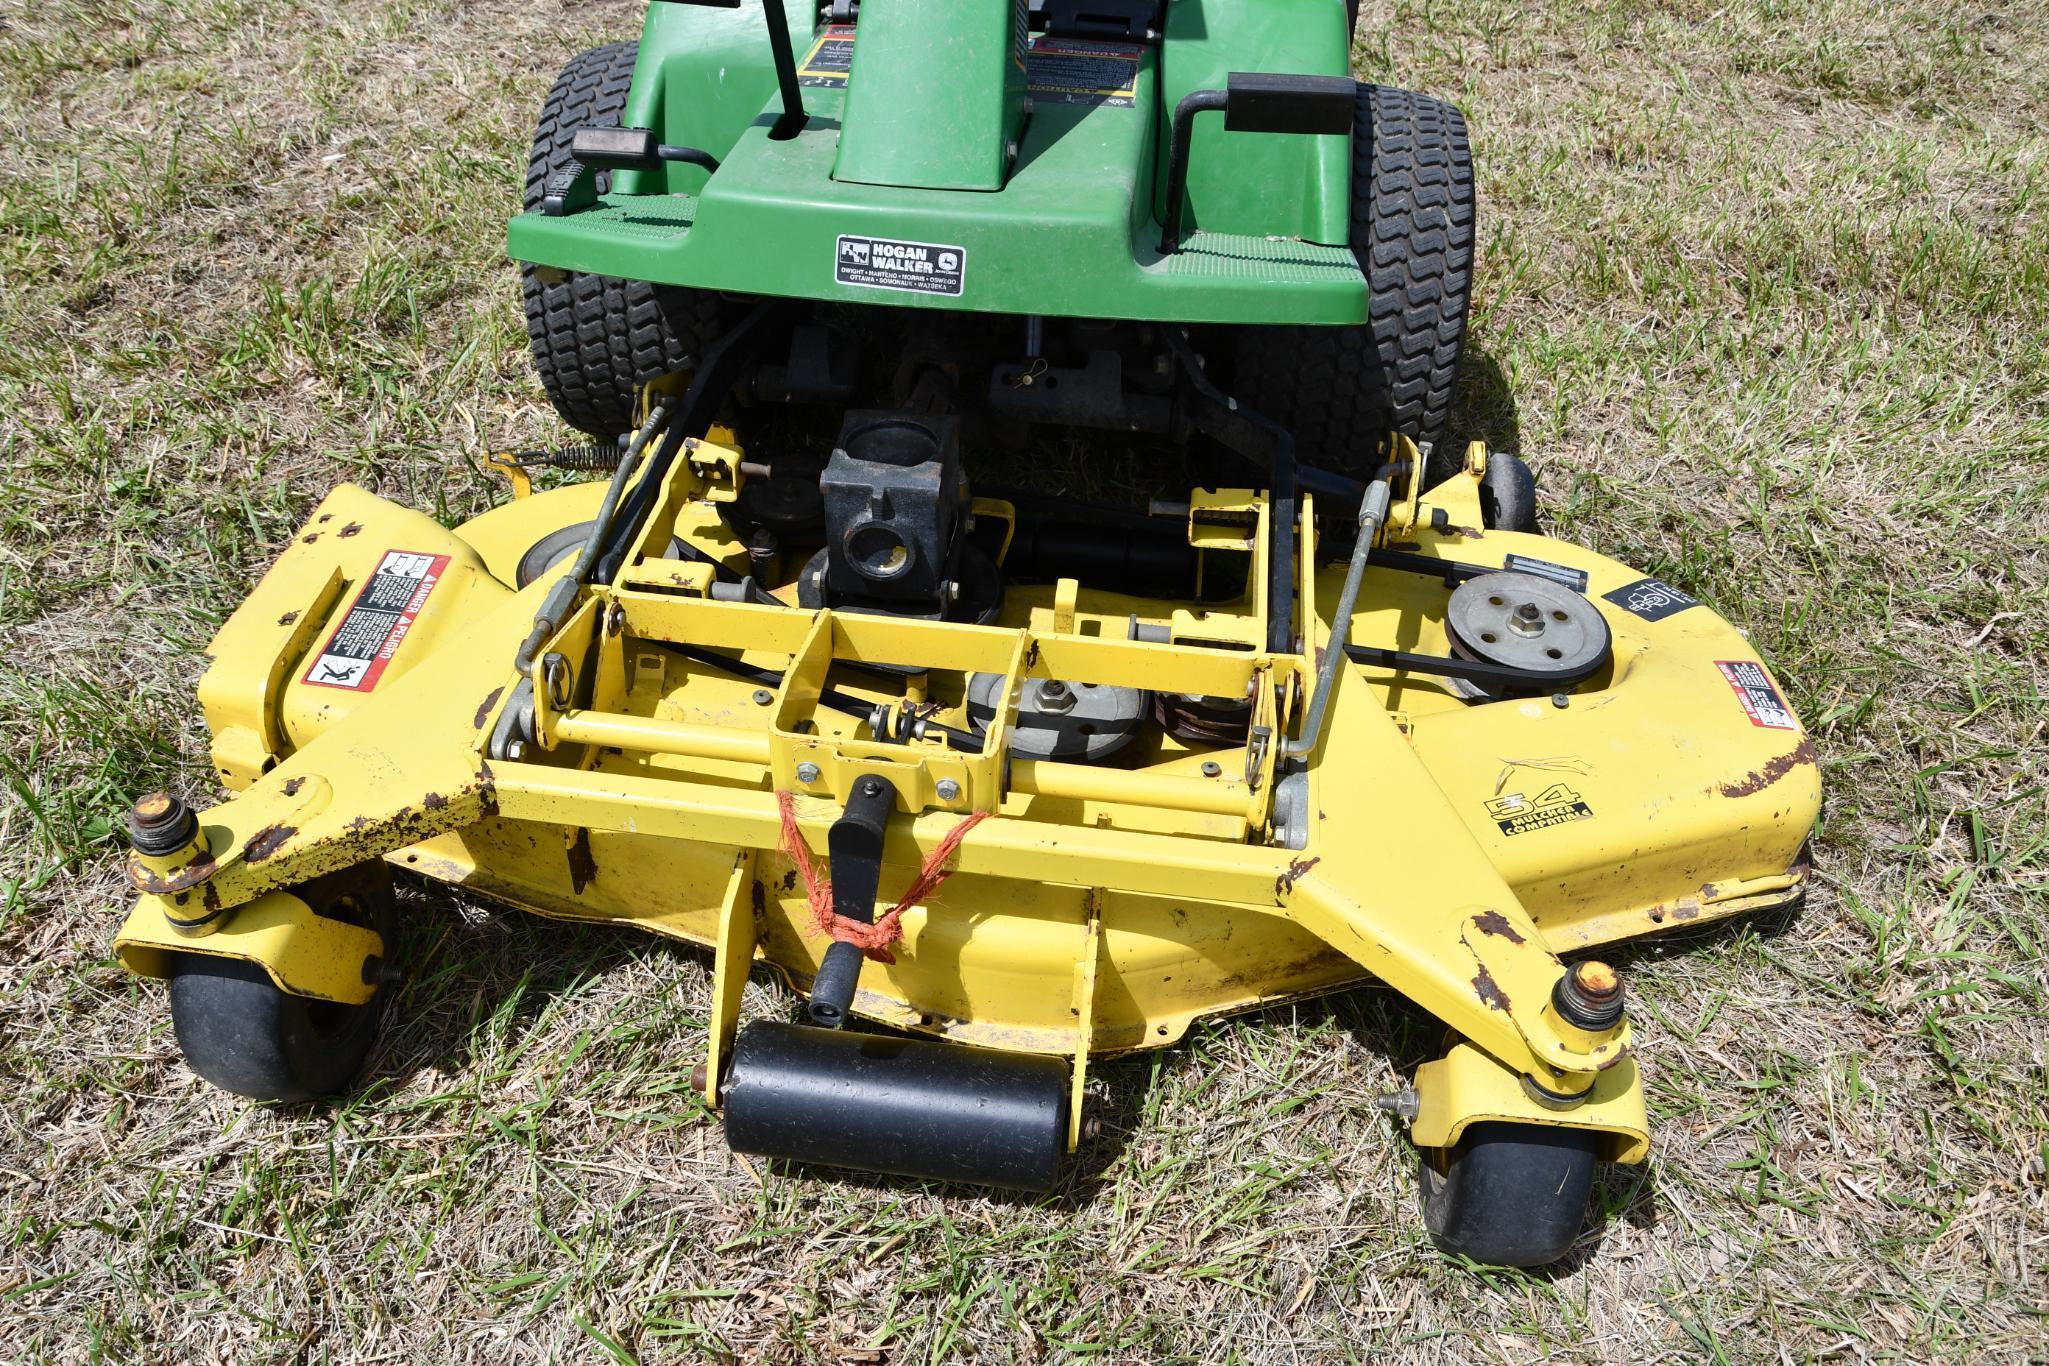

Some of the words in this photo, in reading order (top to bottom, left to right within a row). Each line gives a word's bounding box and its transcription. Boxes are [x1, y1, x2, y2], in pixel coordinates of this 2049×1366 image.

[873, 243, 927, 261] HOGAN
[872, 257, 934, 274] WALKER
[841, 267, 865, 275] DWIGHT
[868, 270, 898, 279] MANTENO
[901, 274, 926, 282] MORRIS
[929, 276, 957, 285] OSWEGO
[849, 274, 876, 282] OTTAWA
[878, 277, 913, 287] SOMONAUK
[917, 281, 947, 291] WATSEKA
[407, 584, 432, 613] DANGER
[380, 625, 408, 659] PELIGRO
[1483, 782, 1581, 821] 54
[1511, 805, 1575, 827] MULCHER
